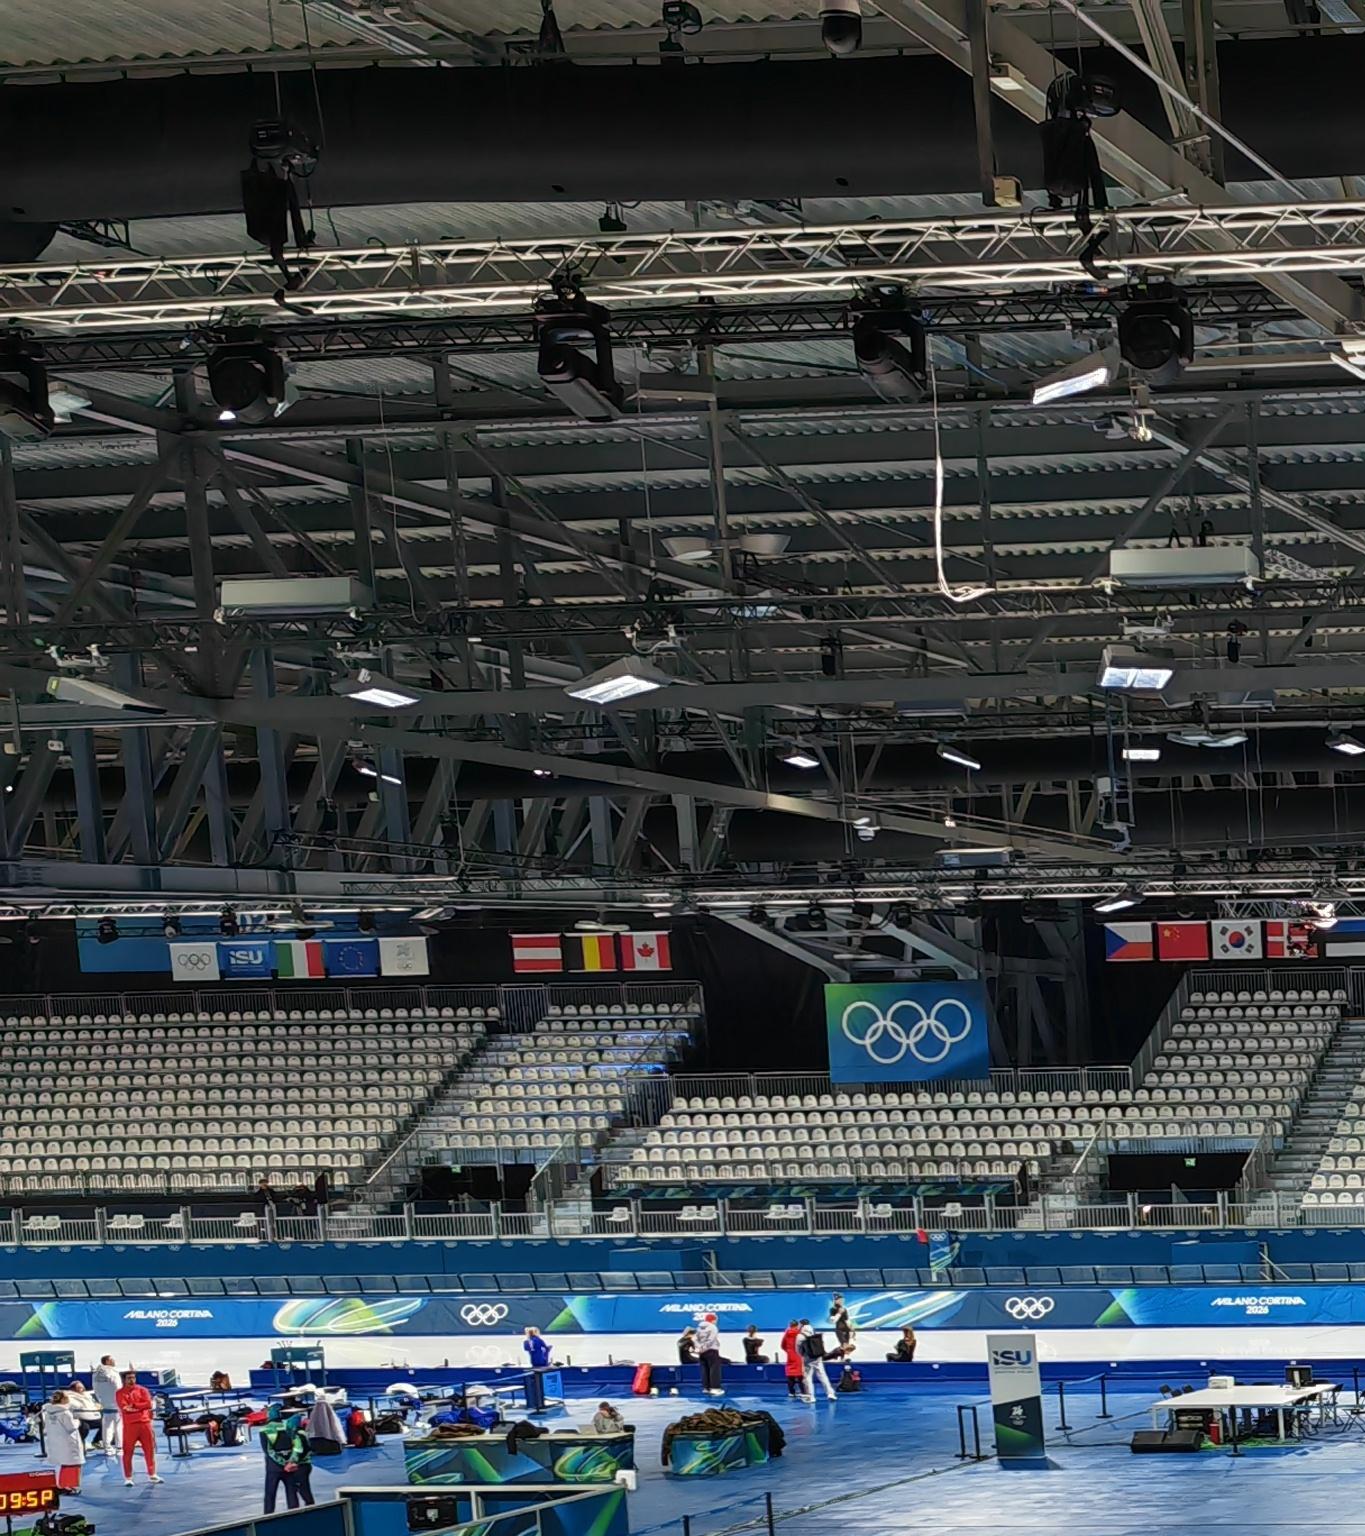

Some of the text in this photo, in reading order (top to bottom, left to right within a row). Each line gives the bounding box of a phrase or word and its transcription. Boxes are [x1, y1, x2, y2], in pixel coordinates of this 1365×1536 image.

[1211, 1296, 1256, 1306] MILANO
[659, 1303, 705, 1313] MILANO
[1246, 1305, 1269, 1314] 2026
[124, 1309, 167, 1319] MILANO
[156, 1318, 178, 1327] 2026
[992, 1350, 1032, 1365] ISU
